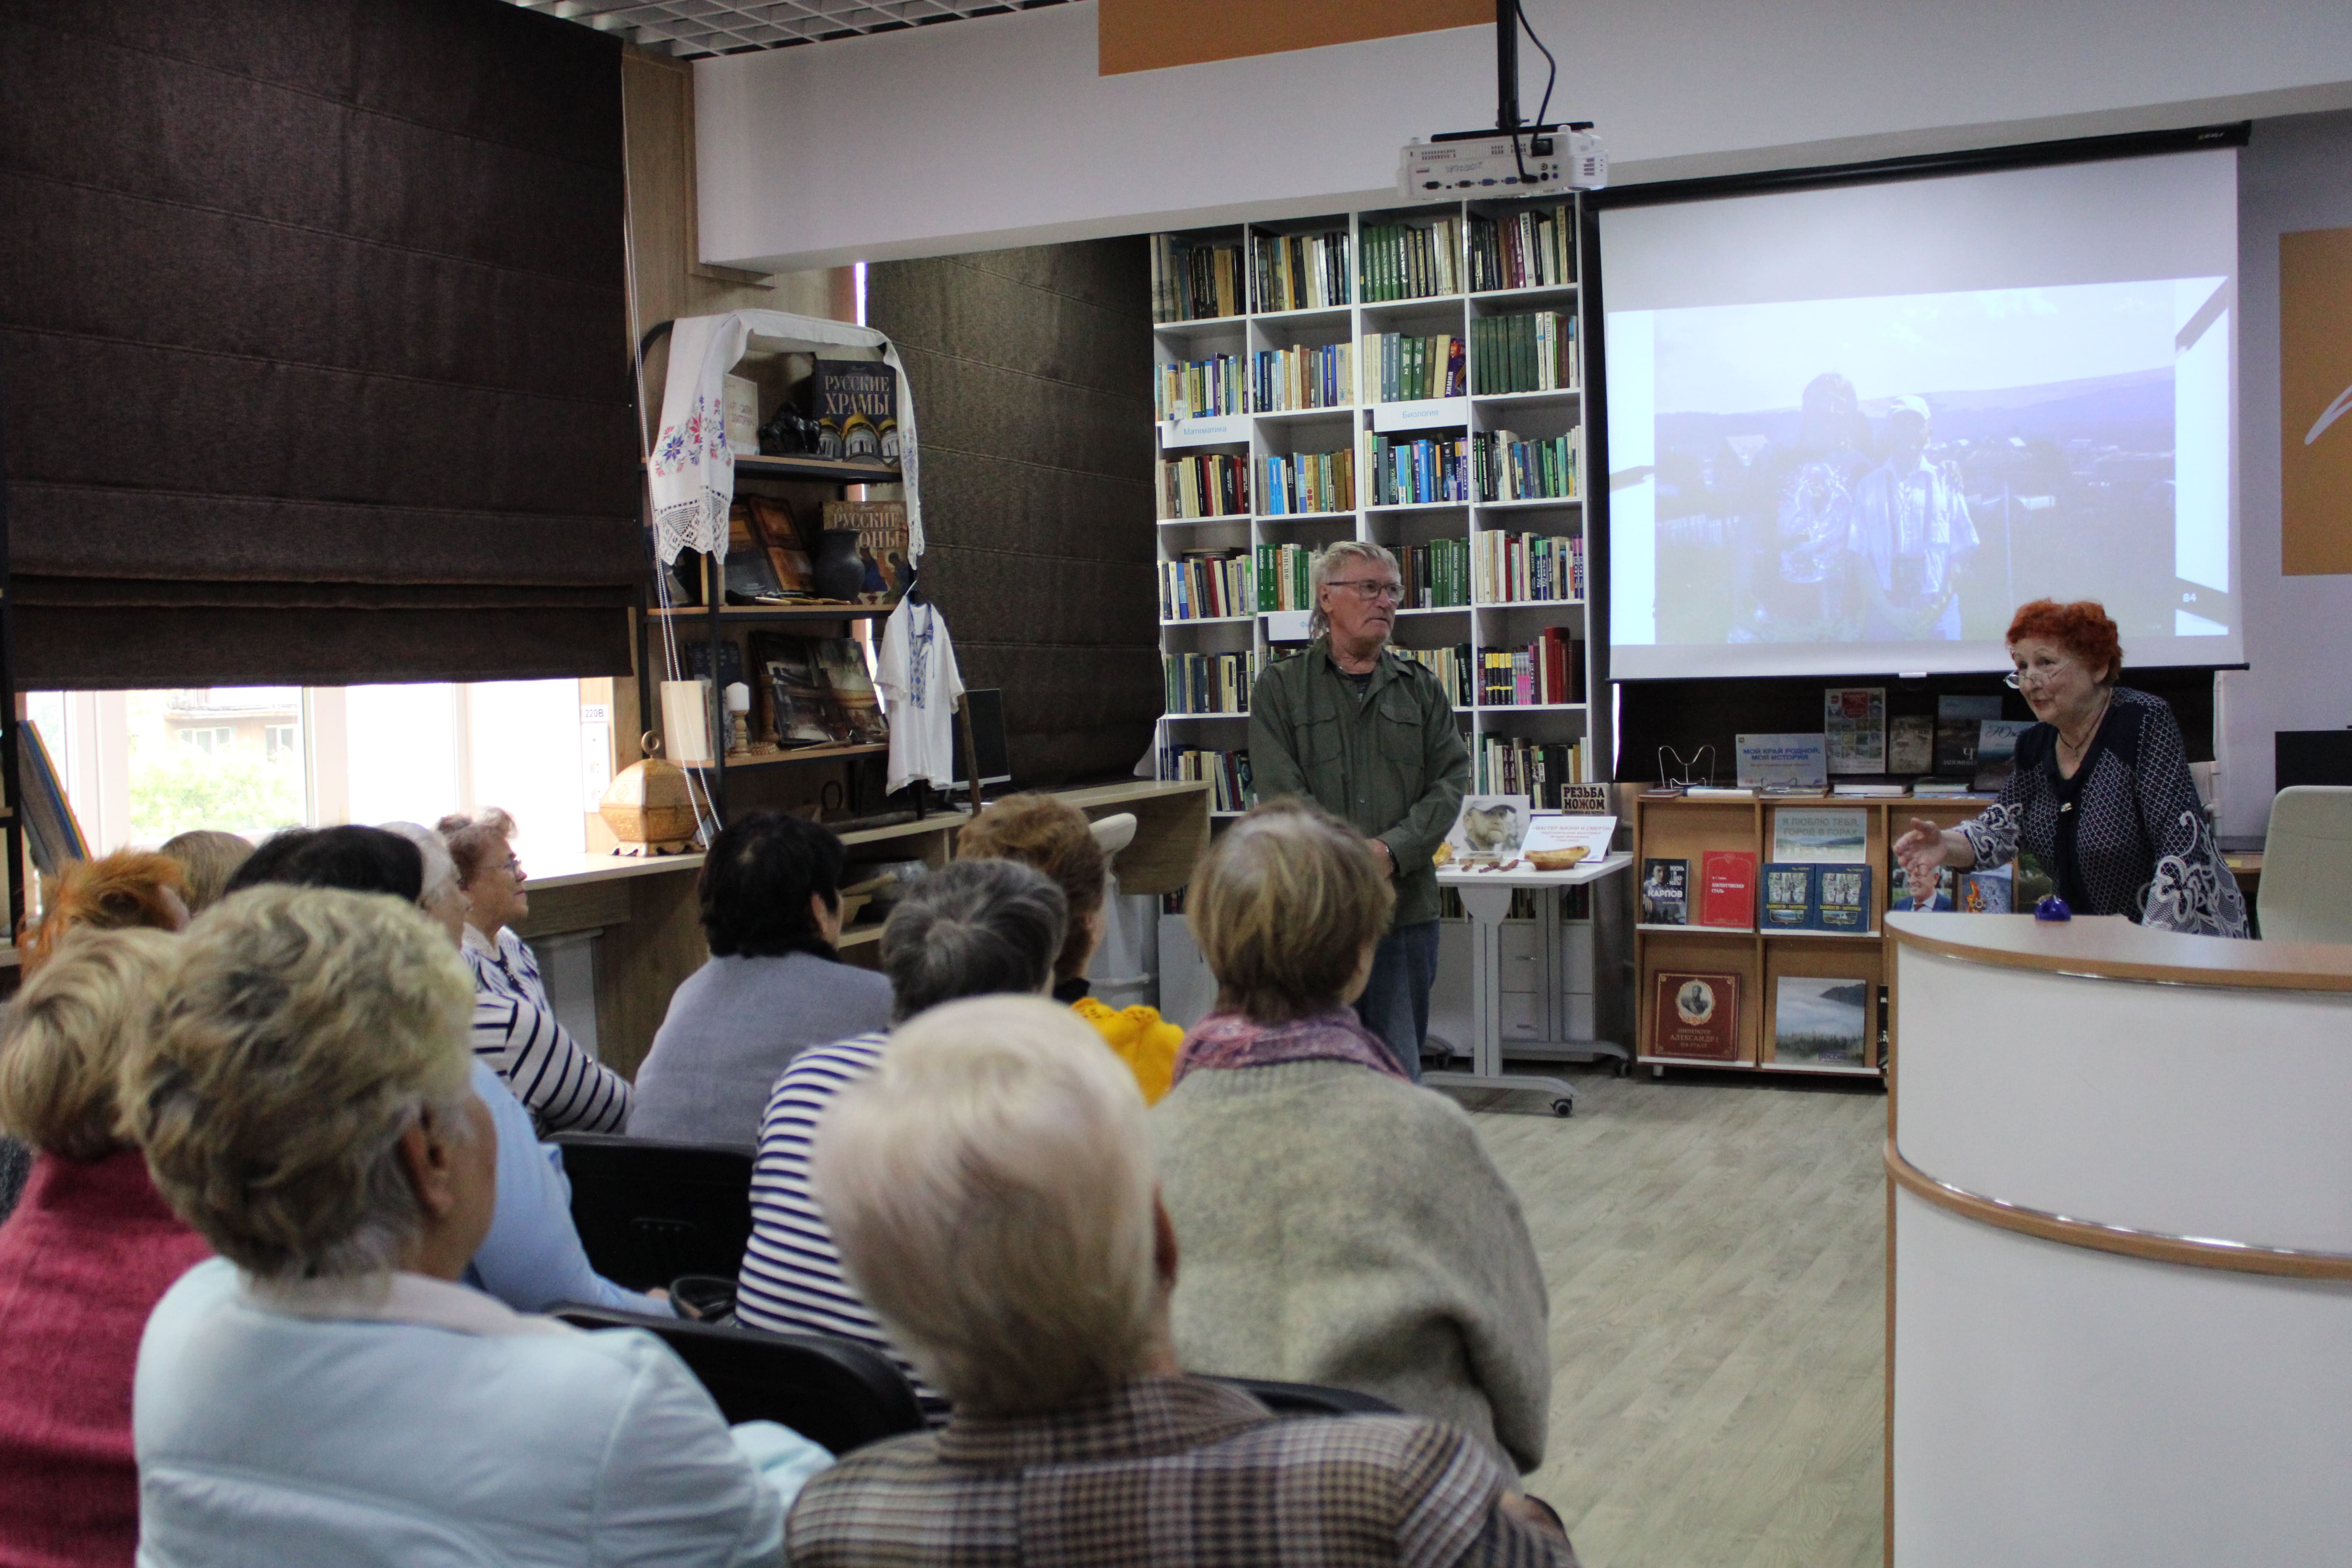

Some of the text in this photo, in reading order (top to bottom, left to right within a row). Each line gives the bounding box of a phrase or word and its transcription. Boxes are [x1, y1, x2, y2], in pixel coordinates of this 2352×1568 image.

[825, 376, 889, 392] РУССКИЕ
[1445, 371, 1454, 395] ХИМИЯ
[825, 393, 889, 415] ХРАМЫ
[1402, 408, 1438, 419] Биология
[1184, 426, 1227, 436] Математика
[833, 512, 900, 529] РУССКИЕ
[2182, 592, 2196, 603] 84
[1563, 787, 1605, 798] РЕЗЬБА
[1564, 799, 1605, 810] НОЖОМ
[1784, 828, 1815, 837] ГОРОД
[1827, 828, 1857, 836] ГОРАХ
